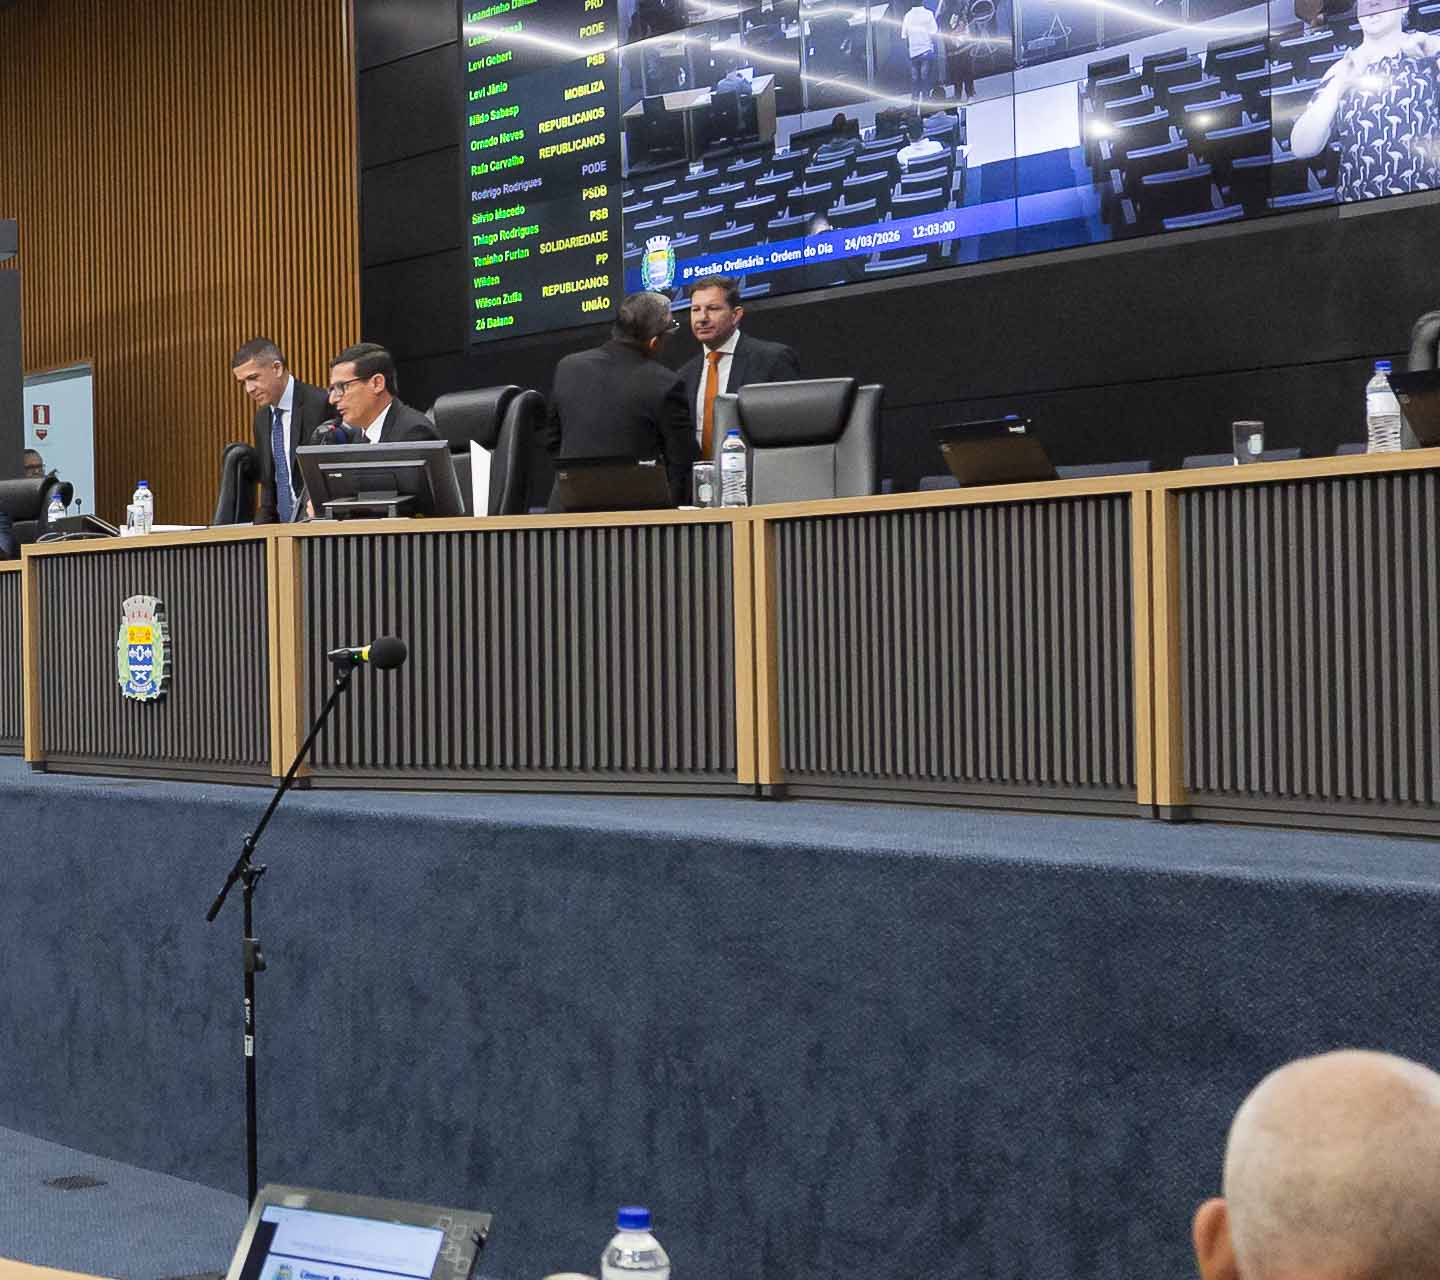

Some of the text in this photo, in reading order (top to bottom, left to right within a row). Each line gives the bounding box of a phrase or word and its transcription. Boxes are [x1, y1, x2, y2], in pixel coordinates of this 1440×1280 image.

[580, 22, 605, 39] PODE
[587, 53, 605, 67] PSB
[565, 80, 605, 100] MOBILIZA
[539, 107, 605, 134] REPUBLICANOS
[539, 133, 606, 159] REPUBLICANOS
[582, 160, 607, 175] PODE
[583, 185, 607, 200] PSDB
[590, 208, 608, 221] PSB
[540, 230, 608, 254] SOLIDARIEDADE
[695, 261, 722, 277] Sessão
[724, 254, 764, 272] Ordinária
[771, 248, 801, 264] Ordem
[803, 244, 816, 258] do
[818, 240, 833, 256] Dia
[844, 230, 901, 250] 24/03/2026
[913, 221, 956, 239] 12:03:00
[596, 253, 608, 265] PP
[542, 276, 608, 297] REPUBLICANOS
[582, 297, 610, 312] UNIÃO
